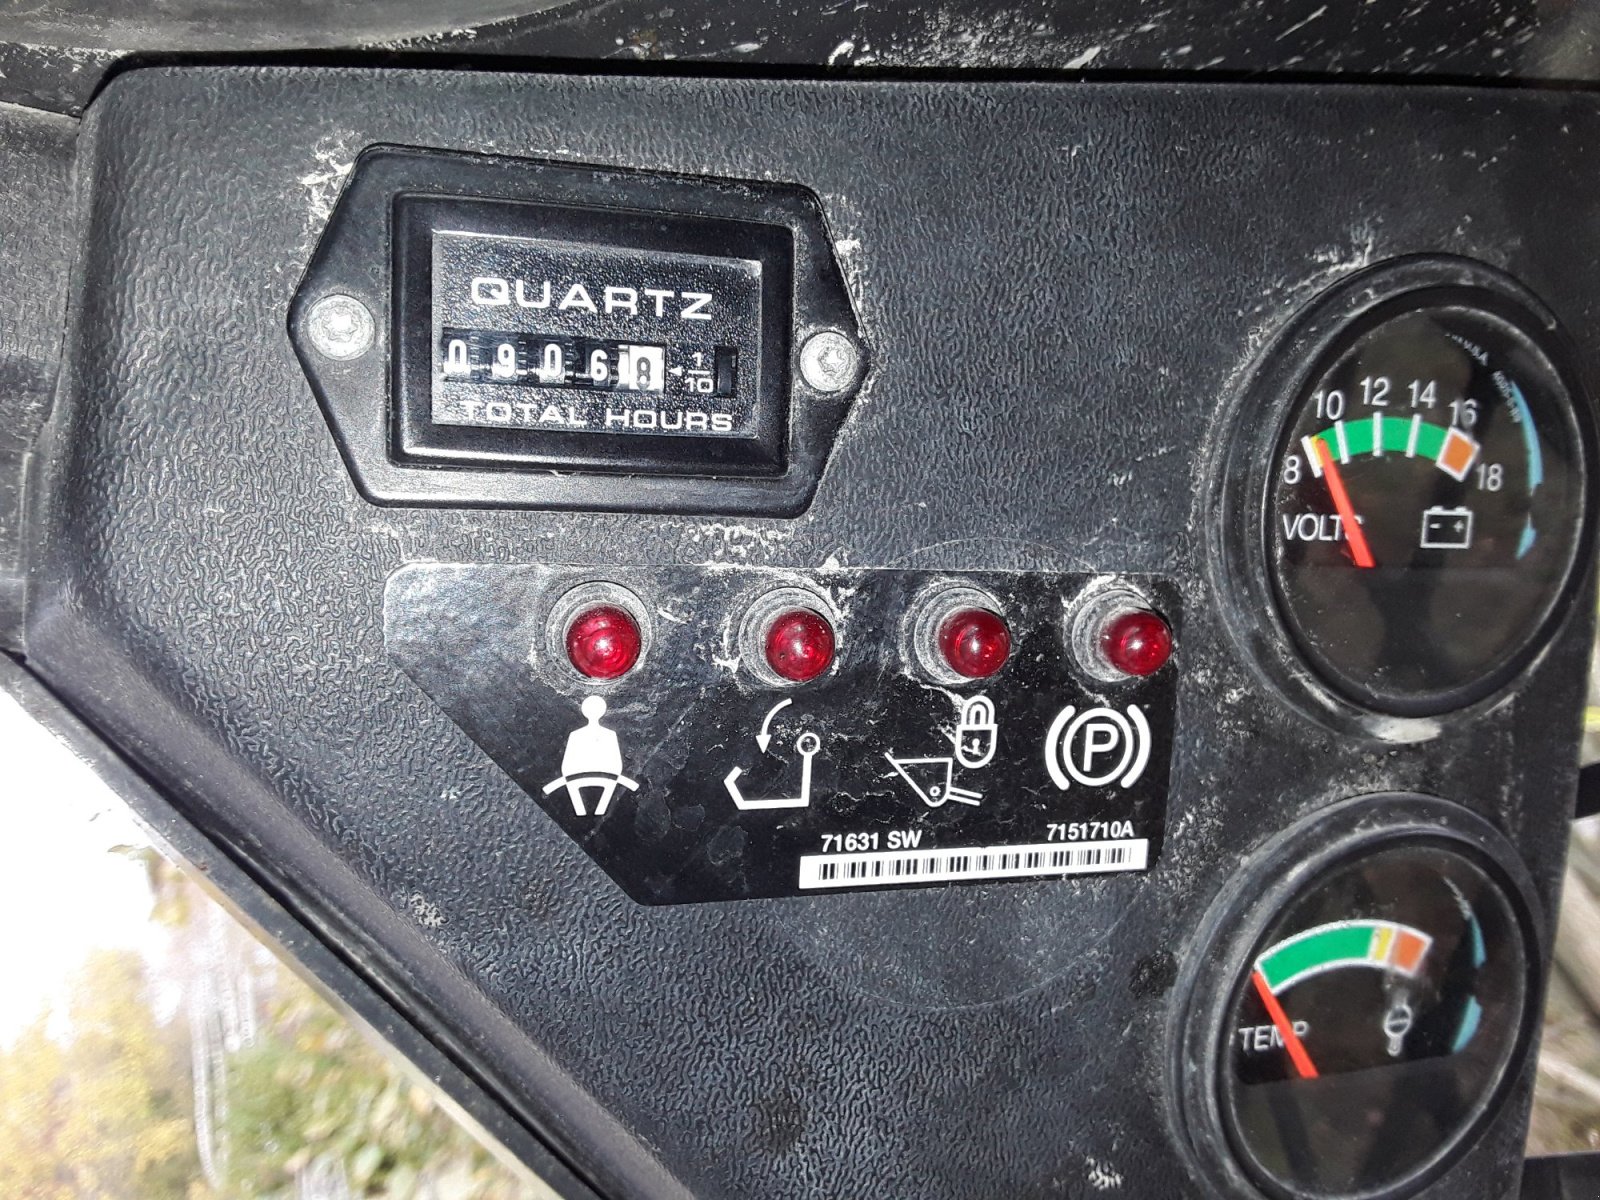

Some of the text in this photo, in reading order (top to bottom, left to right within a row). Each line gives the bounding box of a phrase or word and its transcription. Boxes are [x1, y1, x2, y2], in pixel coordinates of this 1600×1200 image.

[471, 277, 713, 320] QUARTZ
[1314, 390, 1344, 420] 10
[1360, 376, 1391, 406] 12
[1408, 379, 1436, 409] 14
[459, 399, 733, 432] TOTAL HOURS
[1448, 399, 1478, 428] 16
[1283, 456, 1301, 485] 8
[1476, 463, 1503, 491] 18
[1282, 512, 1365, 541] VOLT
[821, 830, 922, 853] 71631 SW
[1046, 820, 1135, 841] 7151710A
